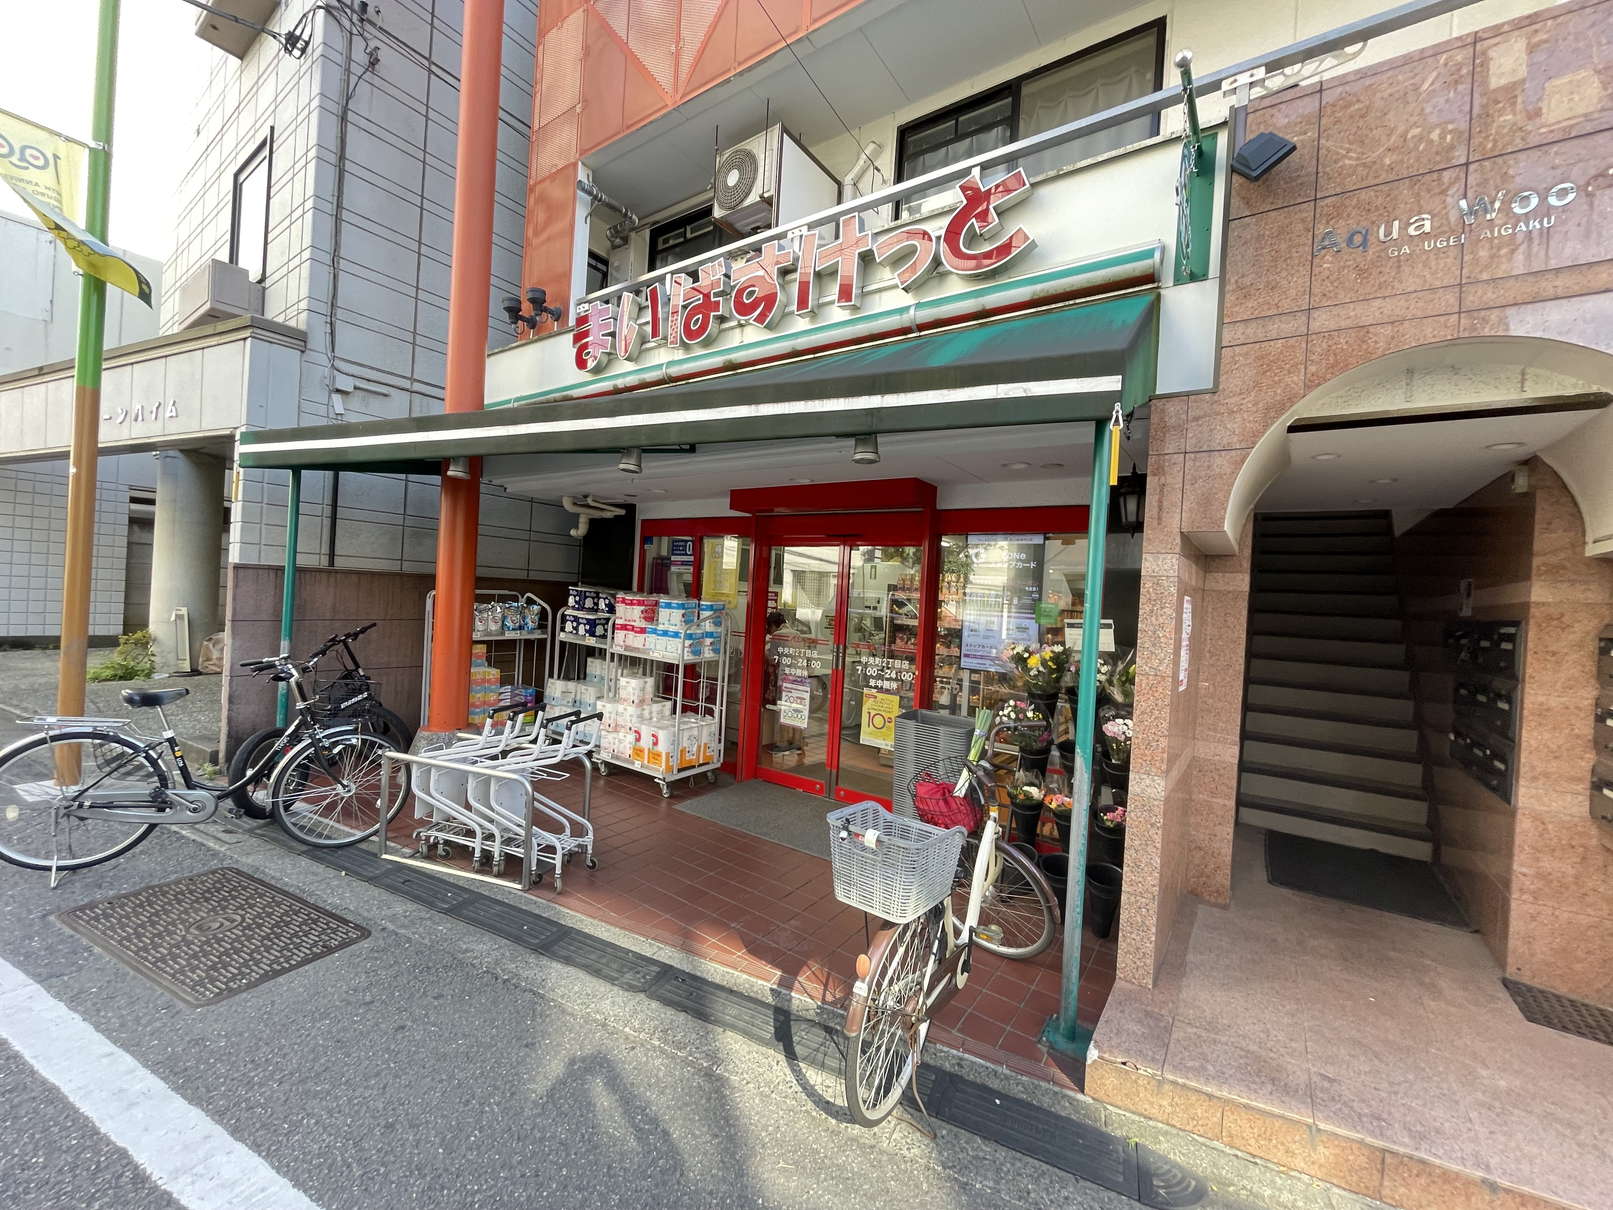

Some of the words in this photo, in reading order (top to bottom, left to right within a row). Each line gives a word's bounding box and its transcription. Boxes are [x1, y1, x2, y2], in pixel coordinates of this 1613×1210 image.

[1313, 214, 1432, 256] Aqua
[572, 168, 1039, 372] まいばすけっと
[103, 400, 178, 424] ーンハイム
[860, 656, 910, 669] 中央町2丁目店
[866, 711, 886, 730] 10
